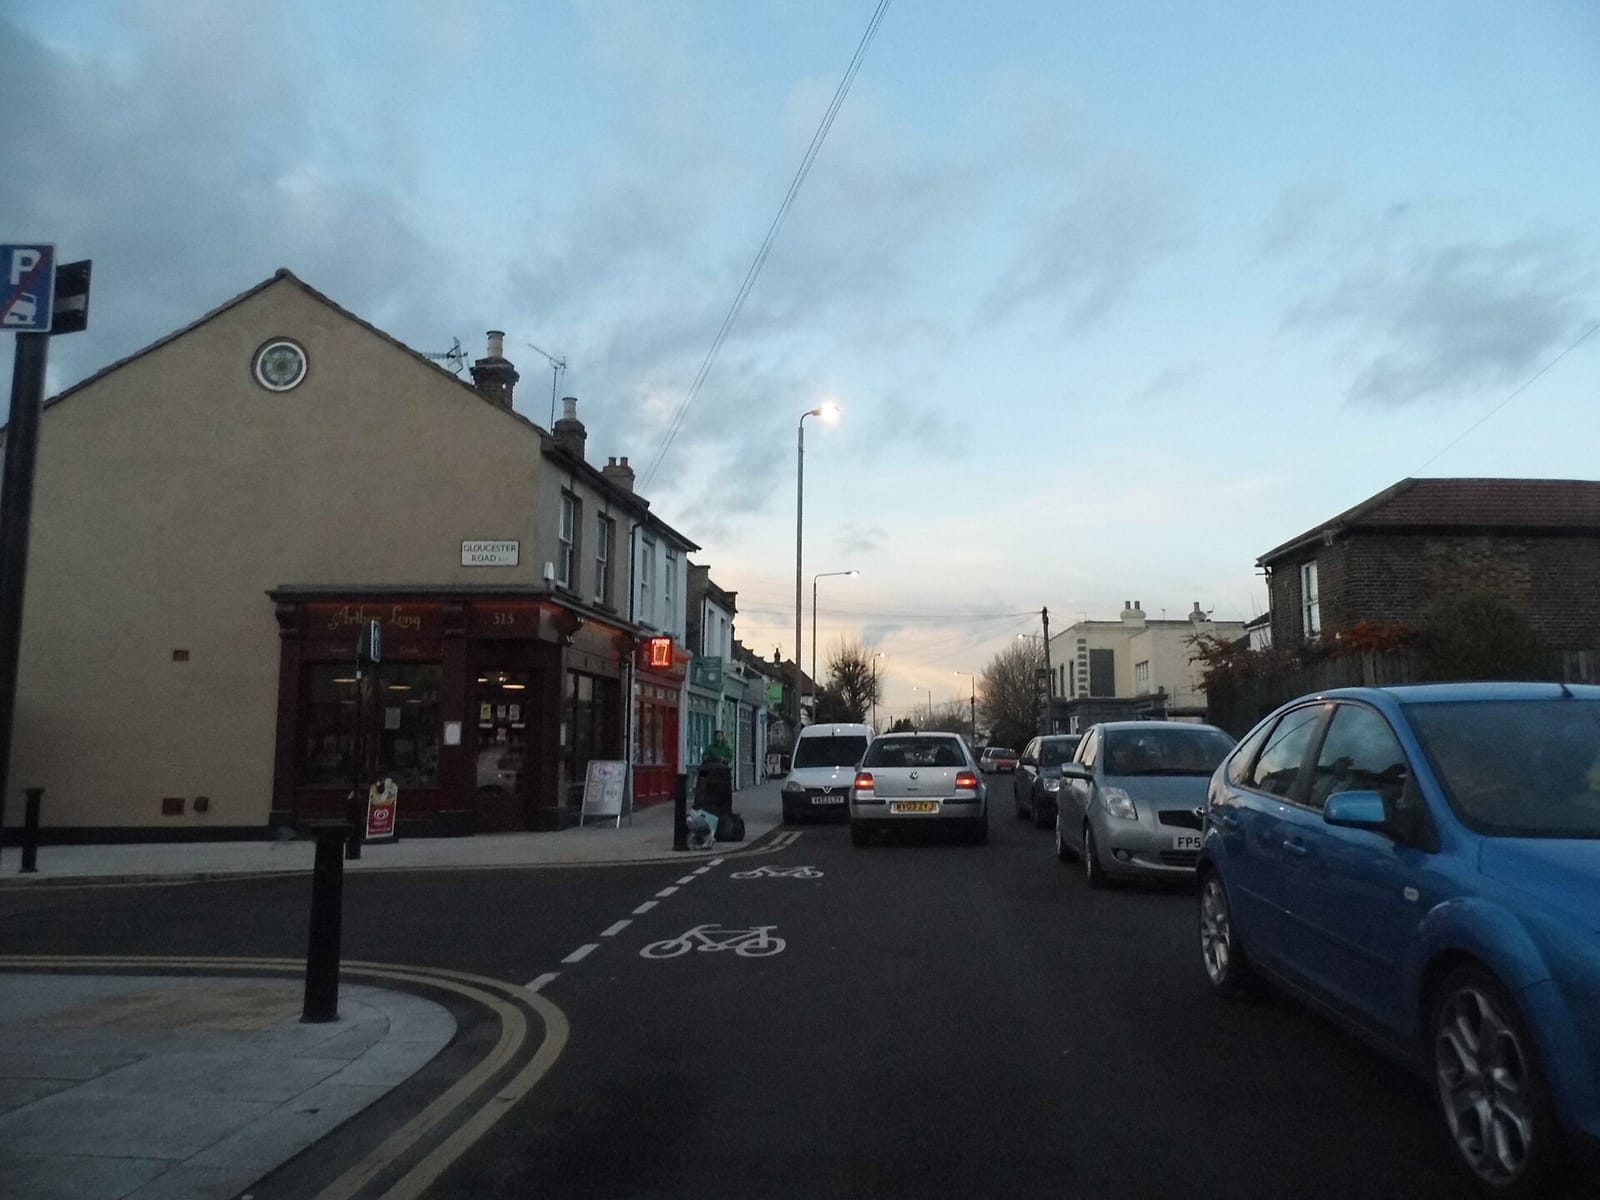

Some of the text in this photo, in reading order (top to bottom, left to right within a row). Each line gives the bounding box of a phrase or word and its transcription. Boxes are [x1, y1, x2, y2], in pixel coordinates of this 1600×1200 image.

[463, 543, 517, 553] GLOUCESTER
[471, 554, 497, 562] ROAD
[388, 606, 421, 630] Long
[651, 638, 670, 646] FOOD
[1177, 836, 1201, 848] FP5
